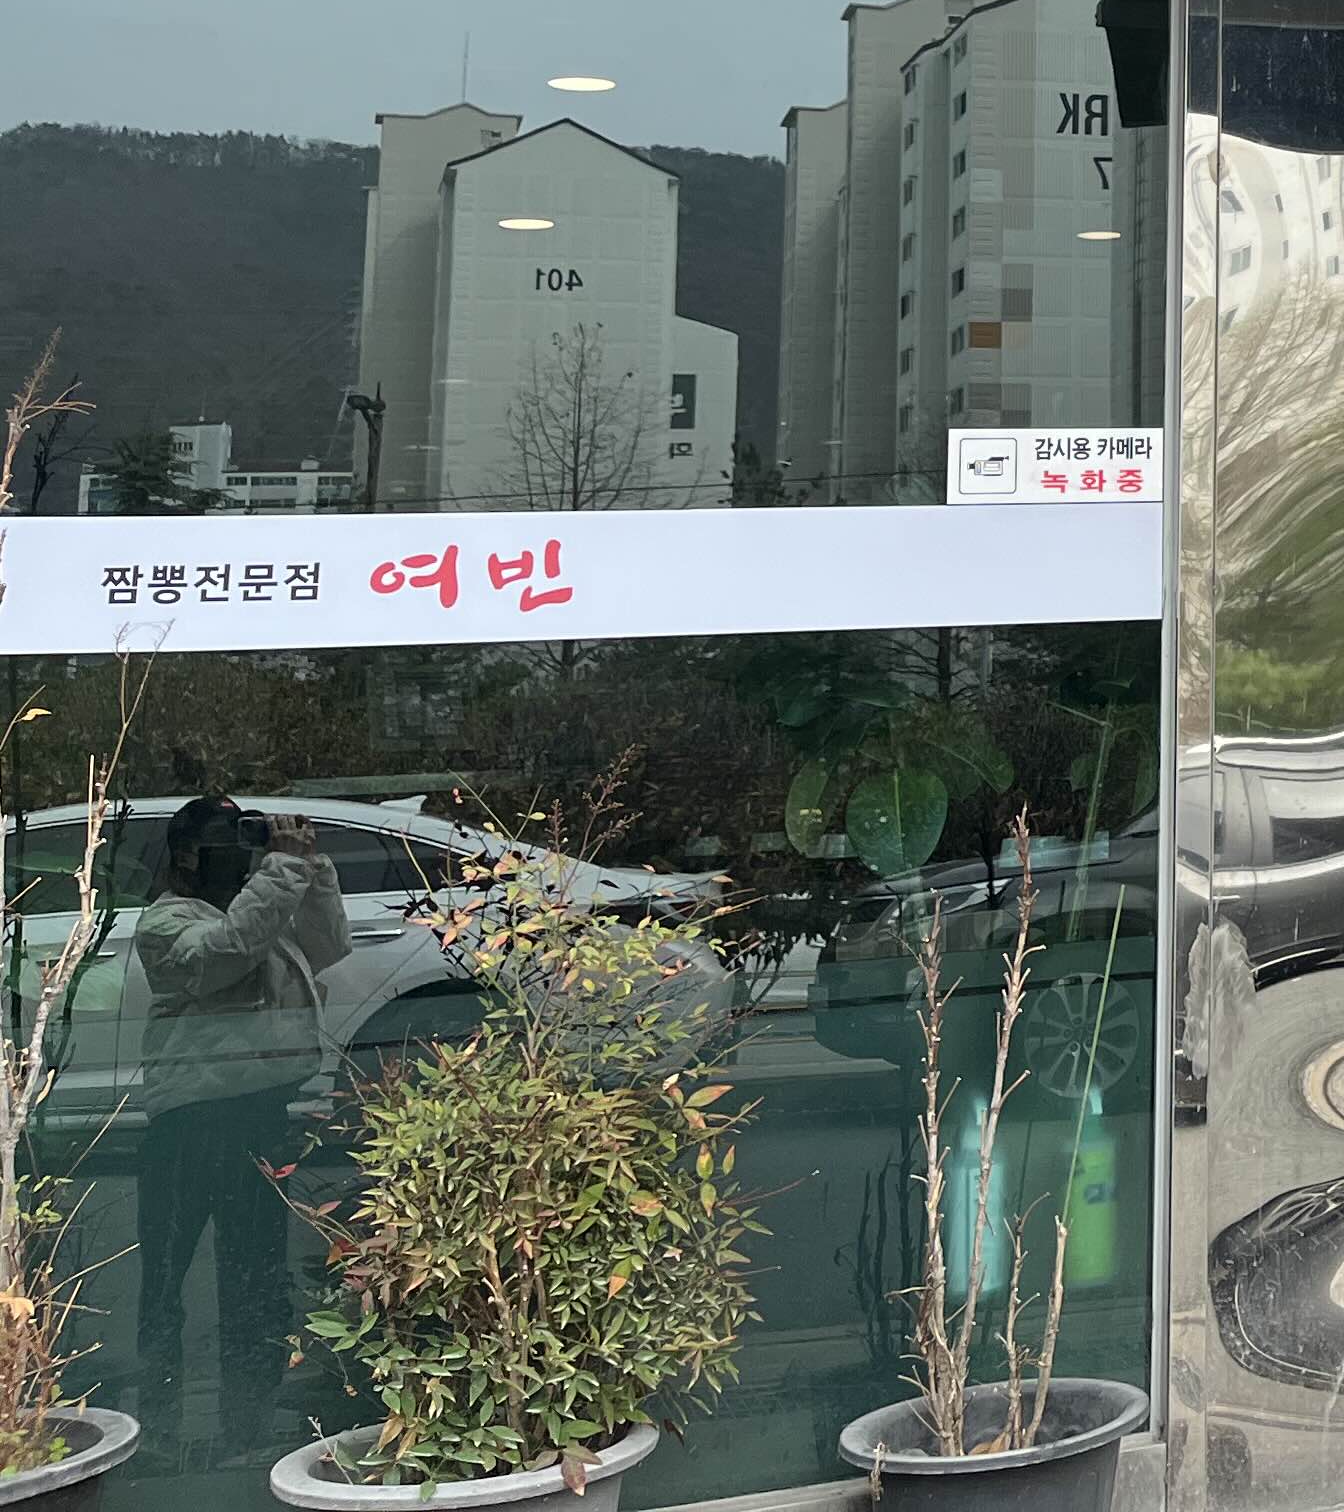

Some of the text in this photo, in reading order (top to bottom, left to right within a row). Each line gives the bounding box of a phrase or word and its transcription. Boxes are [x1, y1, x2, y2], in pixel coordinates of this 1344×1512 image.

[1035, 436, 1153, 460] 감시용 카메라
[101, 539, 573, 612] 짬뽕전문점 여빈
